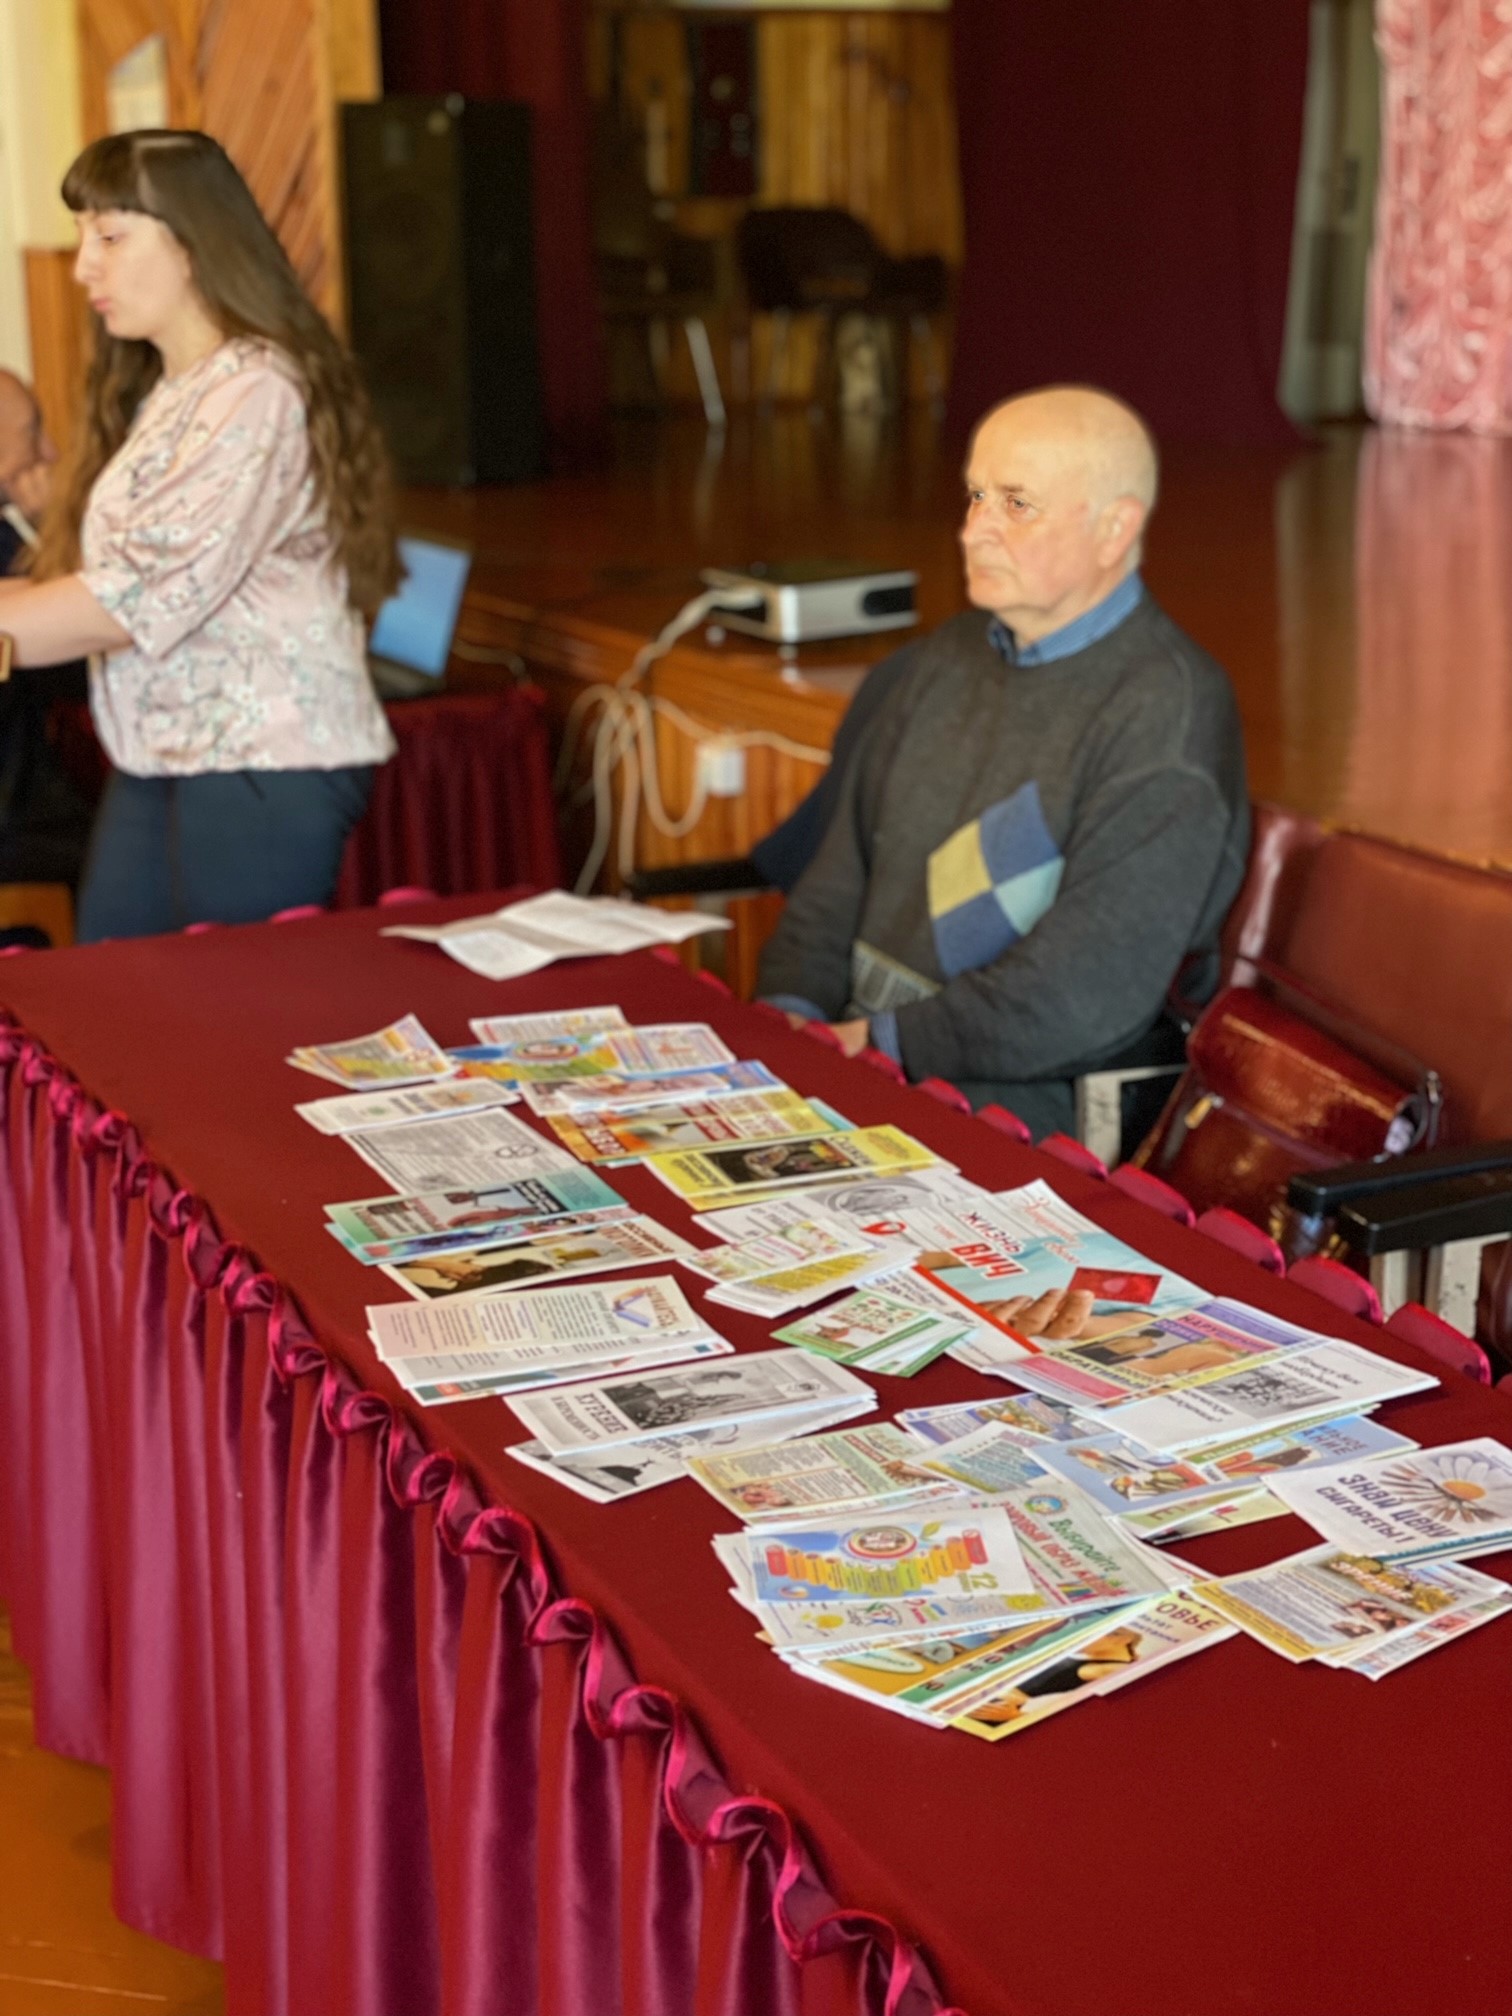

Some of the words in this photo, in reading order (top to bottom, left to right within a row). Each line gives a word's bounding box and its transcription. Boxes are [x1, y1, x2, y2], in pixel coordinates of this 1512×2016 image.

[962, 1211, 1022, 1254] ЖИЗНЬ
[951, 1243, 1027, 1278] ВИЧ
[1337, 1473, 1400, 1509] ЗНАЙ
[1389, 1508, 1460, 1538] ЦЕНУ
